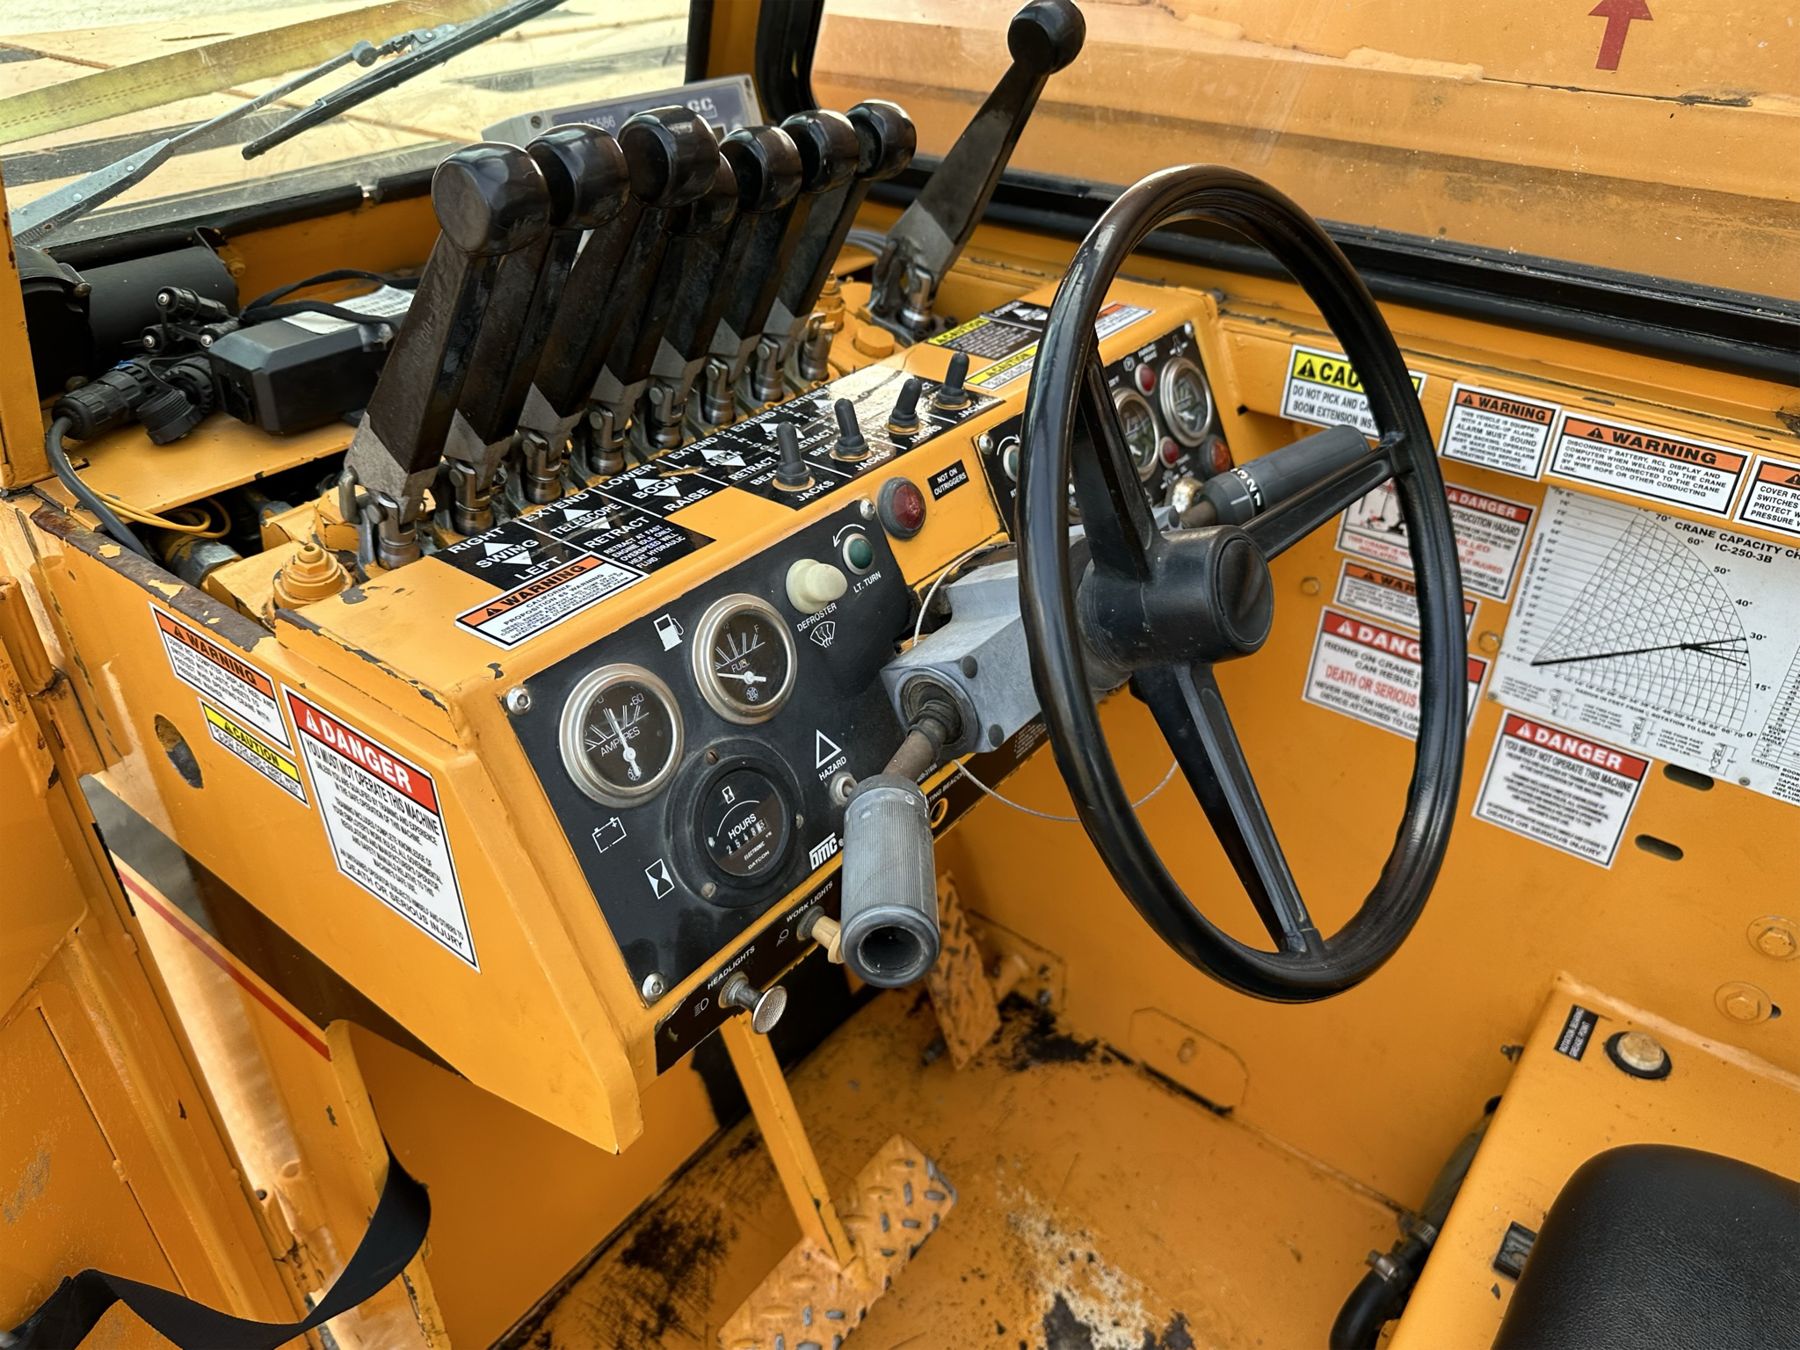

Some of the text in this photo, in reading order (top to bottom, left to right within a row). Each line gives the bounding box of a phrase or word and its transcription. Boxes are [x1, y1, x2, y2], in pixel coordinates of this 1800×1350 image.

[1293, 385, 1303, 396] DO
[1306, 389, 1320, 399] NOT
[1322, 392, 1338, 404] PICK
[1342, 398, 1357, 408] AND
[1480, 397, 1545, 420] WARNING
[730, 412, 776, 432] EXTEND
[1294, 401, 1314, 414] BOOM
[1317, 406, 1357, 424] EXTENSION
[1456, 424, 1536, 446] ALARM MUST SOUND
[668, 437, 718, 459] EXTEND
[810, 440, 836, 456] BEA
[1567, 440, 1612, 453] DISCONNECT
[1670, 464, 1701, 474] DISPLAY
[1613, 432, 1716, 464] WARNING
[595, 465, 656, 489] LOWER
[728, 457, 776, 480] RETRACT
[750, 470, 777, 485] BEA
[937, 468, 957, 483] NOT ON
[1566, 446, 1604, 458] COMPUTER
[1608, 456, 1628, 464] WHEN
[1632, 462, 1664, 473] WELDING
[1700, 478, 1726, 488] CRANE
[1577, 456, 1612, 468] ANYTHING
[1615, 465, 1659, 478] CONNECTED
[1693, 483, 1719, 493] CRANE
[632, 476, 682, 498] BOOM
[797, 481, 834, 501] JACKS
[934, 472, 966, 495] OUTRIGGERS
[1247, 478, 1258, 492] 2
[1630, 475, 1654, 484] OTHER
[1657, 482, 1706, 496] CONDUCTING
[1760, 485, 1788, 497] COVER
[519, 492, 589, 522] EXTEND
[664, 488, 712, 511] RAISE
[1254, 492, 1261, 506] 1
[1460, 494, 1516, 518] DANGER
[1754, 502, 1791, 516] PROTECT
[1757, 494, 1798, 509] SWITCHES
[550, 503, 621, 534] TELESCOPE
[1751, 510, 1794, 525] PRESSURE
[448, 527, 504, 553] RIGHT
[584, 517, 649, 548] RETRACT
[604, 538, 636, 554] RETRACT
[645, 525, 662, 534] FAST
[1675, 522, 1716, 538] CRANE
[1719, 533, 1782, 554] CAPACITY
[1687, 537, 1704, 545] 60°
[476, 540, 539, 567] SWING
[608, 544, 639, 557] ENGINE
[638, 536, 656, 545] IDLE
[616, 533, 678, 560] OVERSPEED WILL
[628, 536, 685, 564] HEAT HYDRAULIC
[1715, 543, 1772, 563] IC-250-3B
[515, 556, 561, 580] LEFT
[1714, 566, 1730, 574] 50°
[500, 563, 586, 606] WARNING
[853, 571, 882, 593] LT. TURN
[504, 598, 556, 625] PROPOSITION
[570, 575, 604, 591] WARNING
[526, 585, 570, 607] CALIFORNIA
[797, 602, 838, 632] DEFROSTER
[1358, 626, 1419, 660] DANG
[1750, 632, 1767, 640] 30°
[186, 633, 257, 685] WARNING
[731, 659, 750, 673] FUEL
[1325, 641, 1414, 676] RIDING ON CRANE
[1356, 662, 1376, 674] CAN
[1326, 665, 1416, 708] DEATH OR SERIOUS
[1755, 683, 1771, 691] 15°
[1651, 713, 1684, 727] ROTATION
[1697, 728, 1716, 737] LOAD
[233, 728, 279, 766] CAUTION
[320, 718, 412, 792] DANGER
[1535, 729, 1622, 769] DANGER
[819, 756, 847, 781] HAZARD
[1506, 740, 1632, 792] YOU MUST NOT OPERATE THIS MACHINE
[1752, 758, 1780, 770] CAUTION
[306, 740, 439, 836] YOU MUST NOT OPERATE THIS MACHINE
[728, 814, 756, 839] HOURS
[346, 860, 462, 948] DEATH OR SERIOUS INJURY
[786, 881, 833, 923] WORK LIGHTS
[707, 946, 755, 990] HEADLIGHTS
